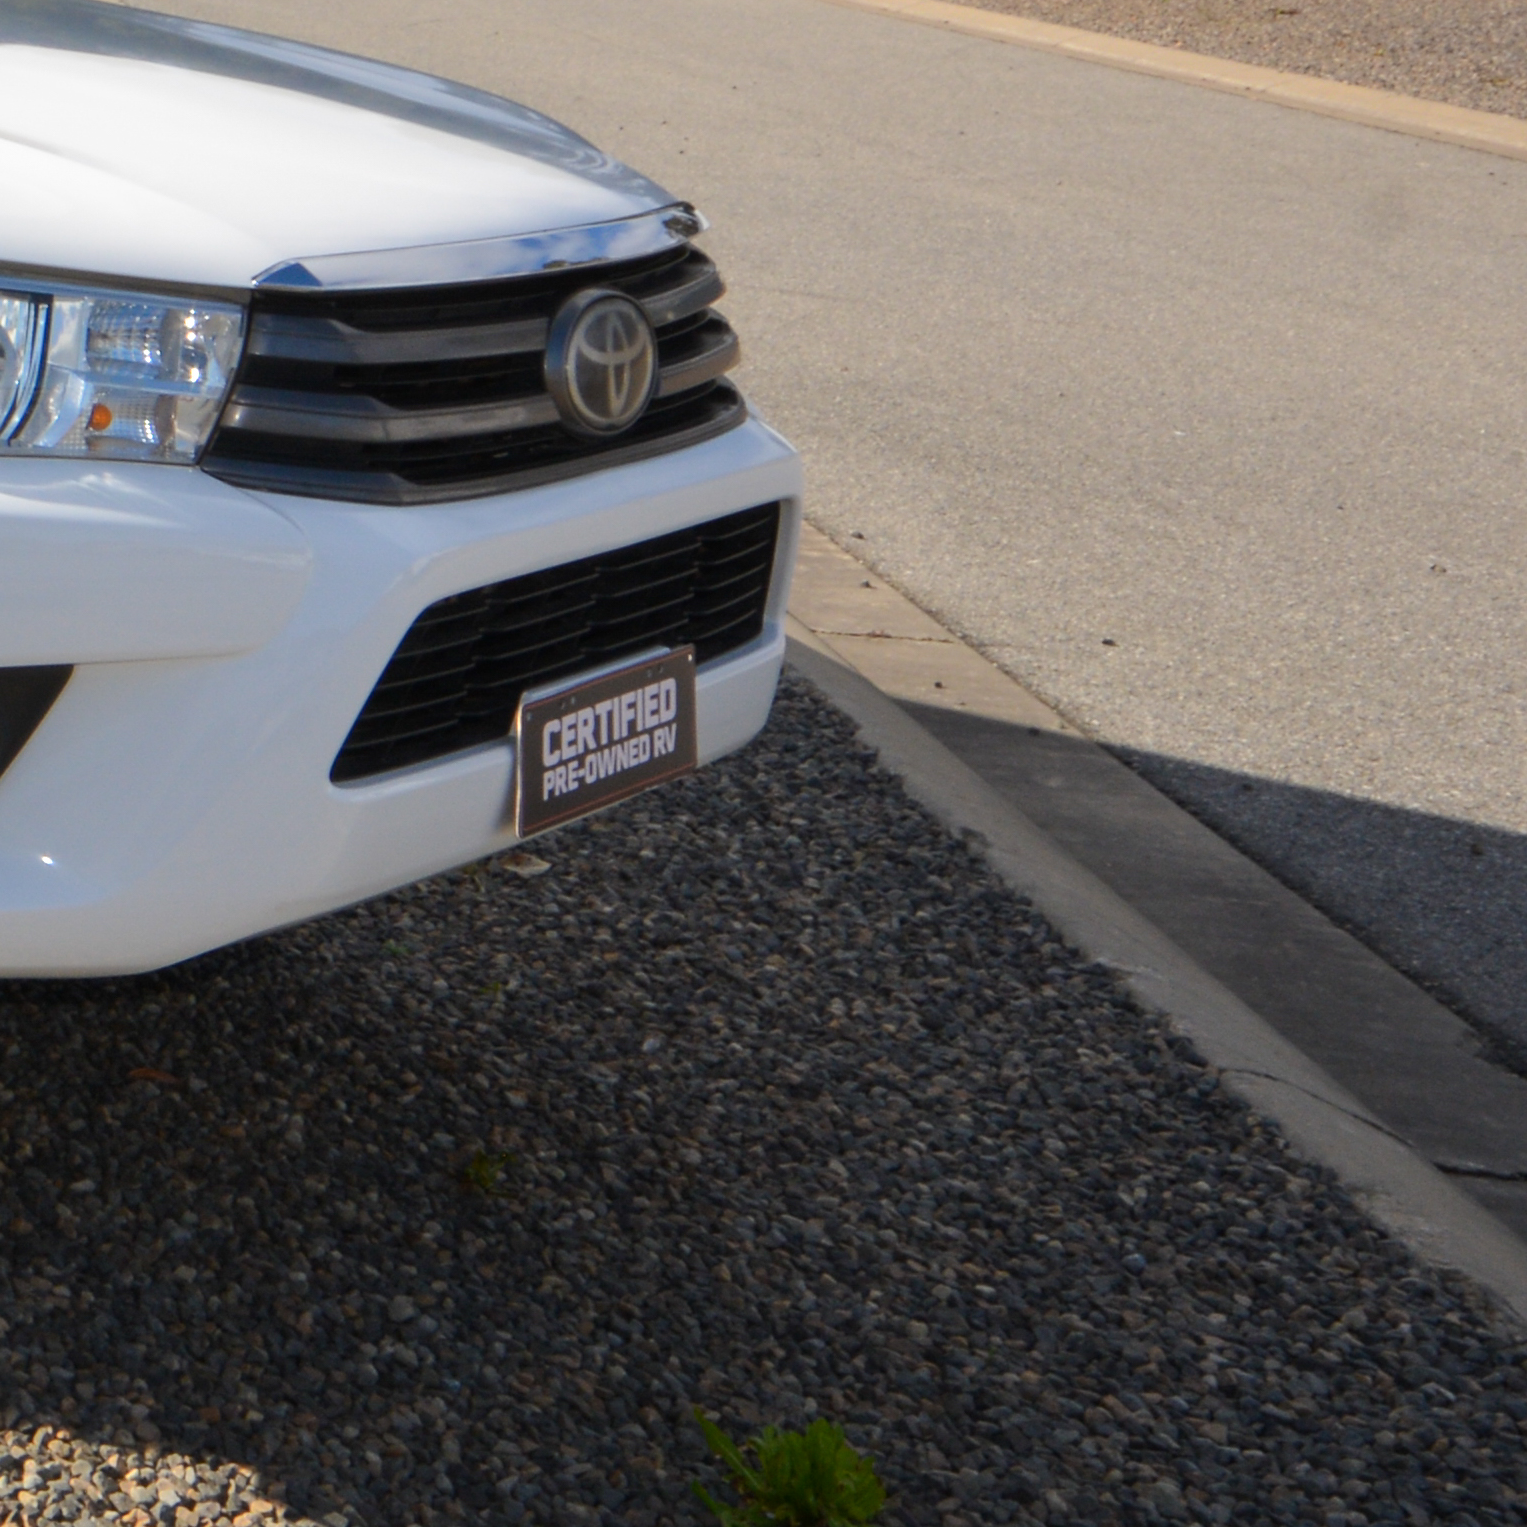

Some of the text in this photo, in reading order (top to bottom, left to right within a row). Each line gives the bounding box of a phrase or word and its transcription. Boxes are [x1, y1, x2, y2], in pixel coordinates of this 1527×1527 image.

[542, 676, 678, 768] CERTIFIED
[542, 723, 678, 802] PRE-OWNED RV
